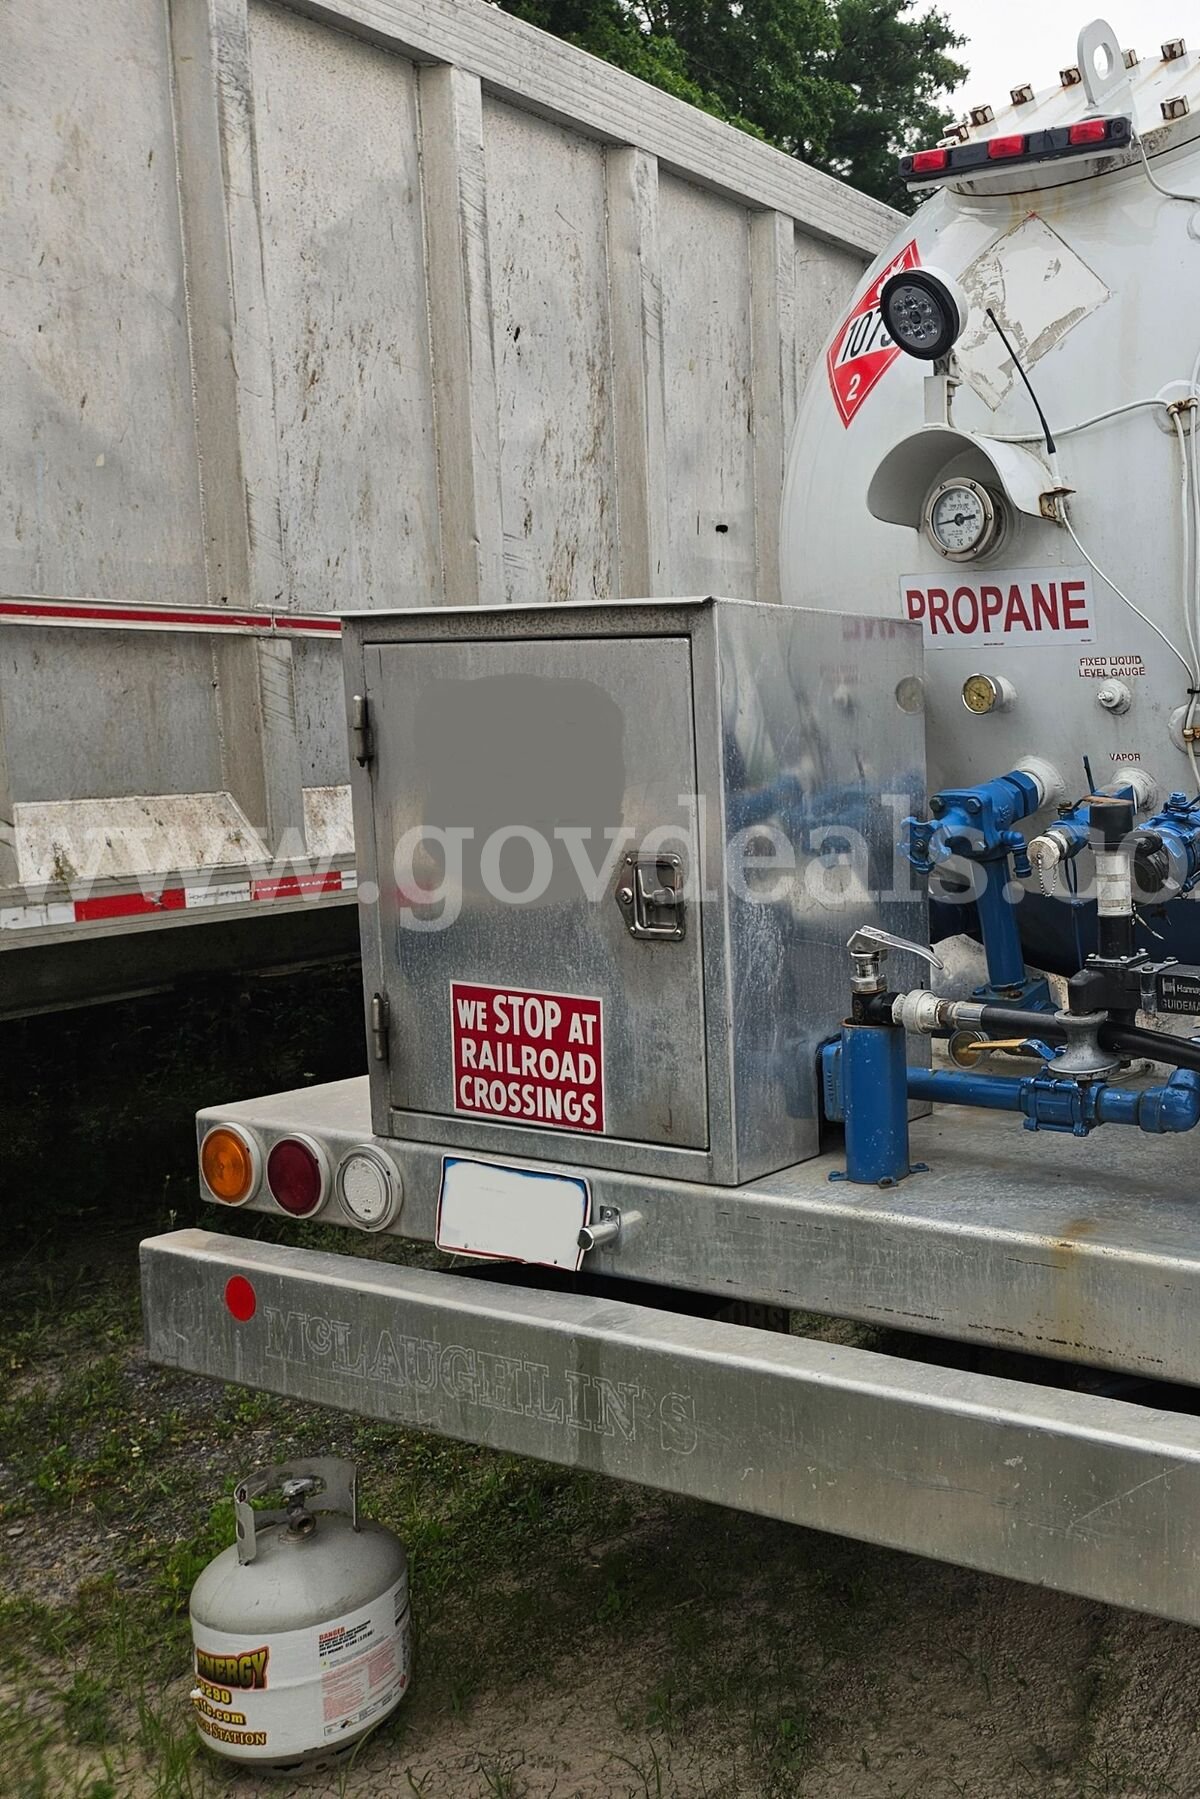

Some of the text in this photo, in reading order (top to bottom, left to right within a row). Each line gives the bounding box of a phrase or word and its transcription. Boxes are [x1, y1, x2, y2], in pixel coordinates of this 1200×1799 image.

[846, 373, 861, 402] 2
[906, 581, 1089, 635] PROPANE
[1078, 666, 1146, 678] LEVEL GAUGE
[1079, 655, 1142, 667] FIXED LIQUID
[1109, 753, 1141, 762] VAPOR
[456, 994, 597, 1046] WE STOP AT
[461, 1037, 597, 1086] RAILROAD
[459, 1074, 598, 1126] CROSSINGS
[319, 1626, 345, 1641] DANGER
